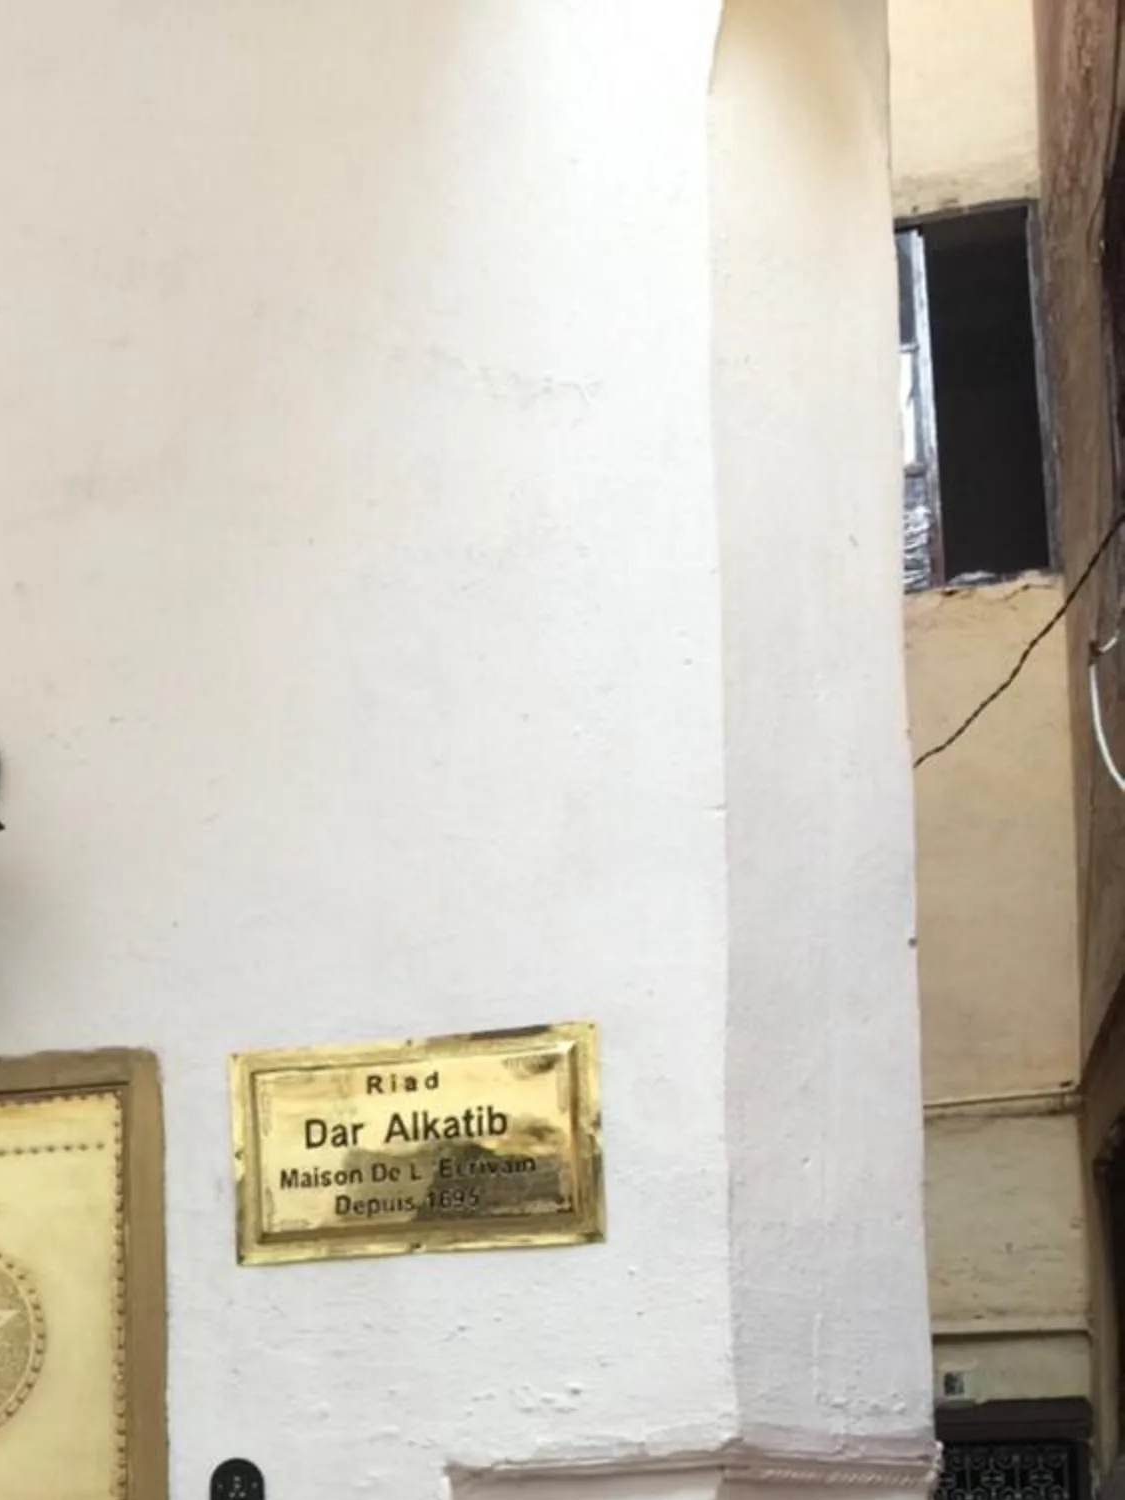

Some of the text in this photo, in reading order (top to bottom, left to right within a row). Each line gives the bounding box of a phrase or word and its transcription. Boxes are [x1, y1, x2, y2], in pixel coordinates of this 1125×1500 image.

[366, 1072, 440, 1095] Riad
[304, 1106, 508, 1149] Dar Alkatib
[280, 1167, 363, 1190] Maison
[371, 1162, 401, 1182] De
[335, 1196, 416, 1219] Depuis
